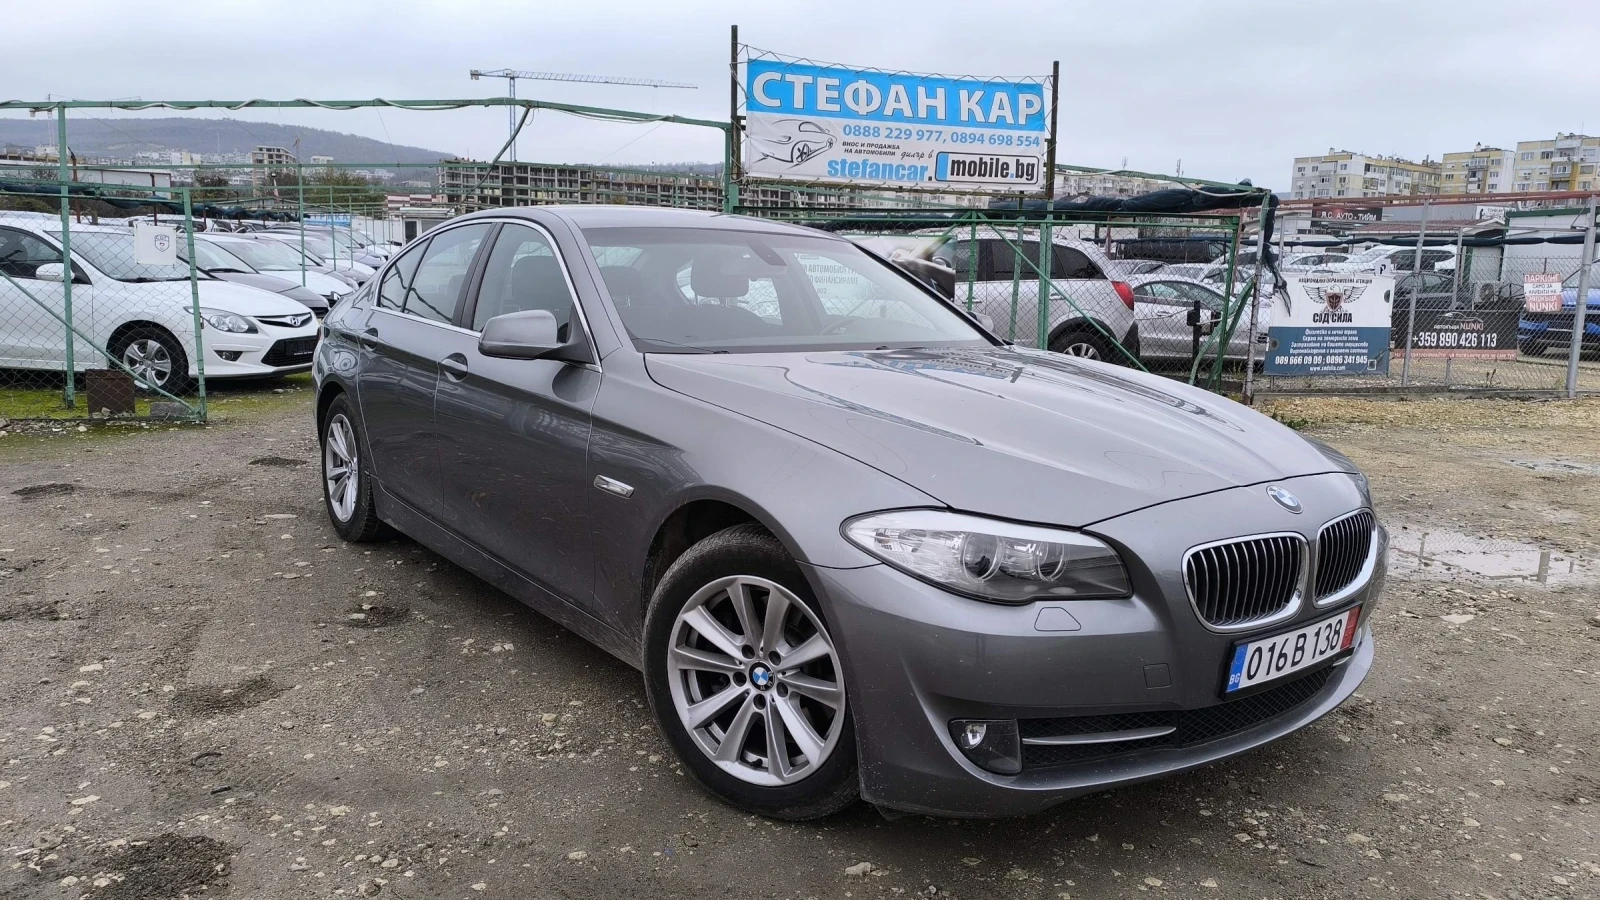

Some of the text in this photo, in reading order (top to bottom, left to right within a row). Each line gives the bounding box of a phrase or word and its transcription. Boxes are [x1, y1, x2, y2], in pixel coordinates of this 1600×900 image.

[752, 71, 1042, 125] СТЕФАН КАР
[843, 124, 1040, 147] 0888 229 977, 0894 698 554
[854, 148, 896, 156] АВТОМОБИЛИ
[950, 157, 1036, 181] mobile.bg
[1336, 212, 1354, 220] АУТО
[1524, 274, 1559, 283] ПАРКИНГ
[1530, 302, 1558, 311] NUNKI
[1313, 312, 1353, 324] СОД СИЛА
[1460, 323, 1484, 331] NUNKI
[1412, 332, 1497, 347] +359 890 426 113
[1275, 355, 1288, 364] 089
[1289, 355, 1302, 364] 666
[1303, 355, 1312, 364] 09
[1313, 355, 1323, 364] 09
[1326, 355, 1343, 364] 0896
[1343, 355, 1355, 364] 341
[1355, 355, 1368, 364] 945
[1229, 673, 1240, 685] BG
